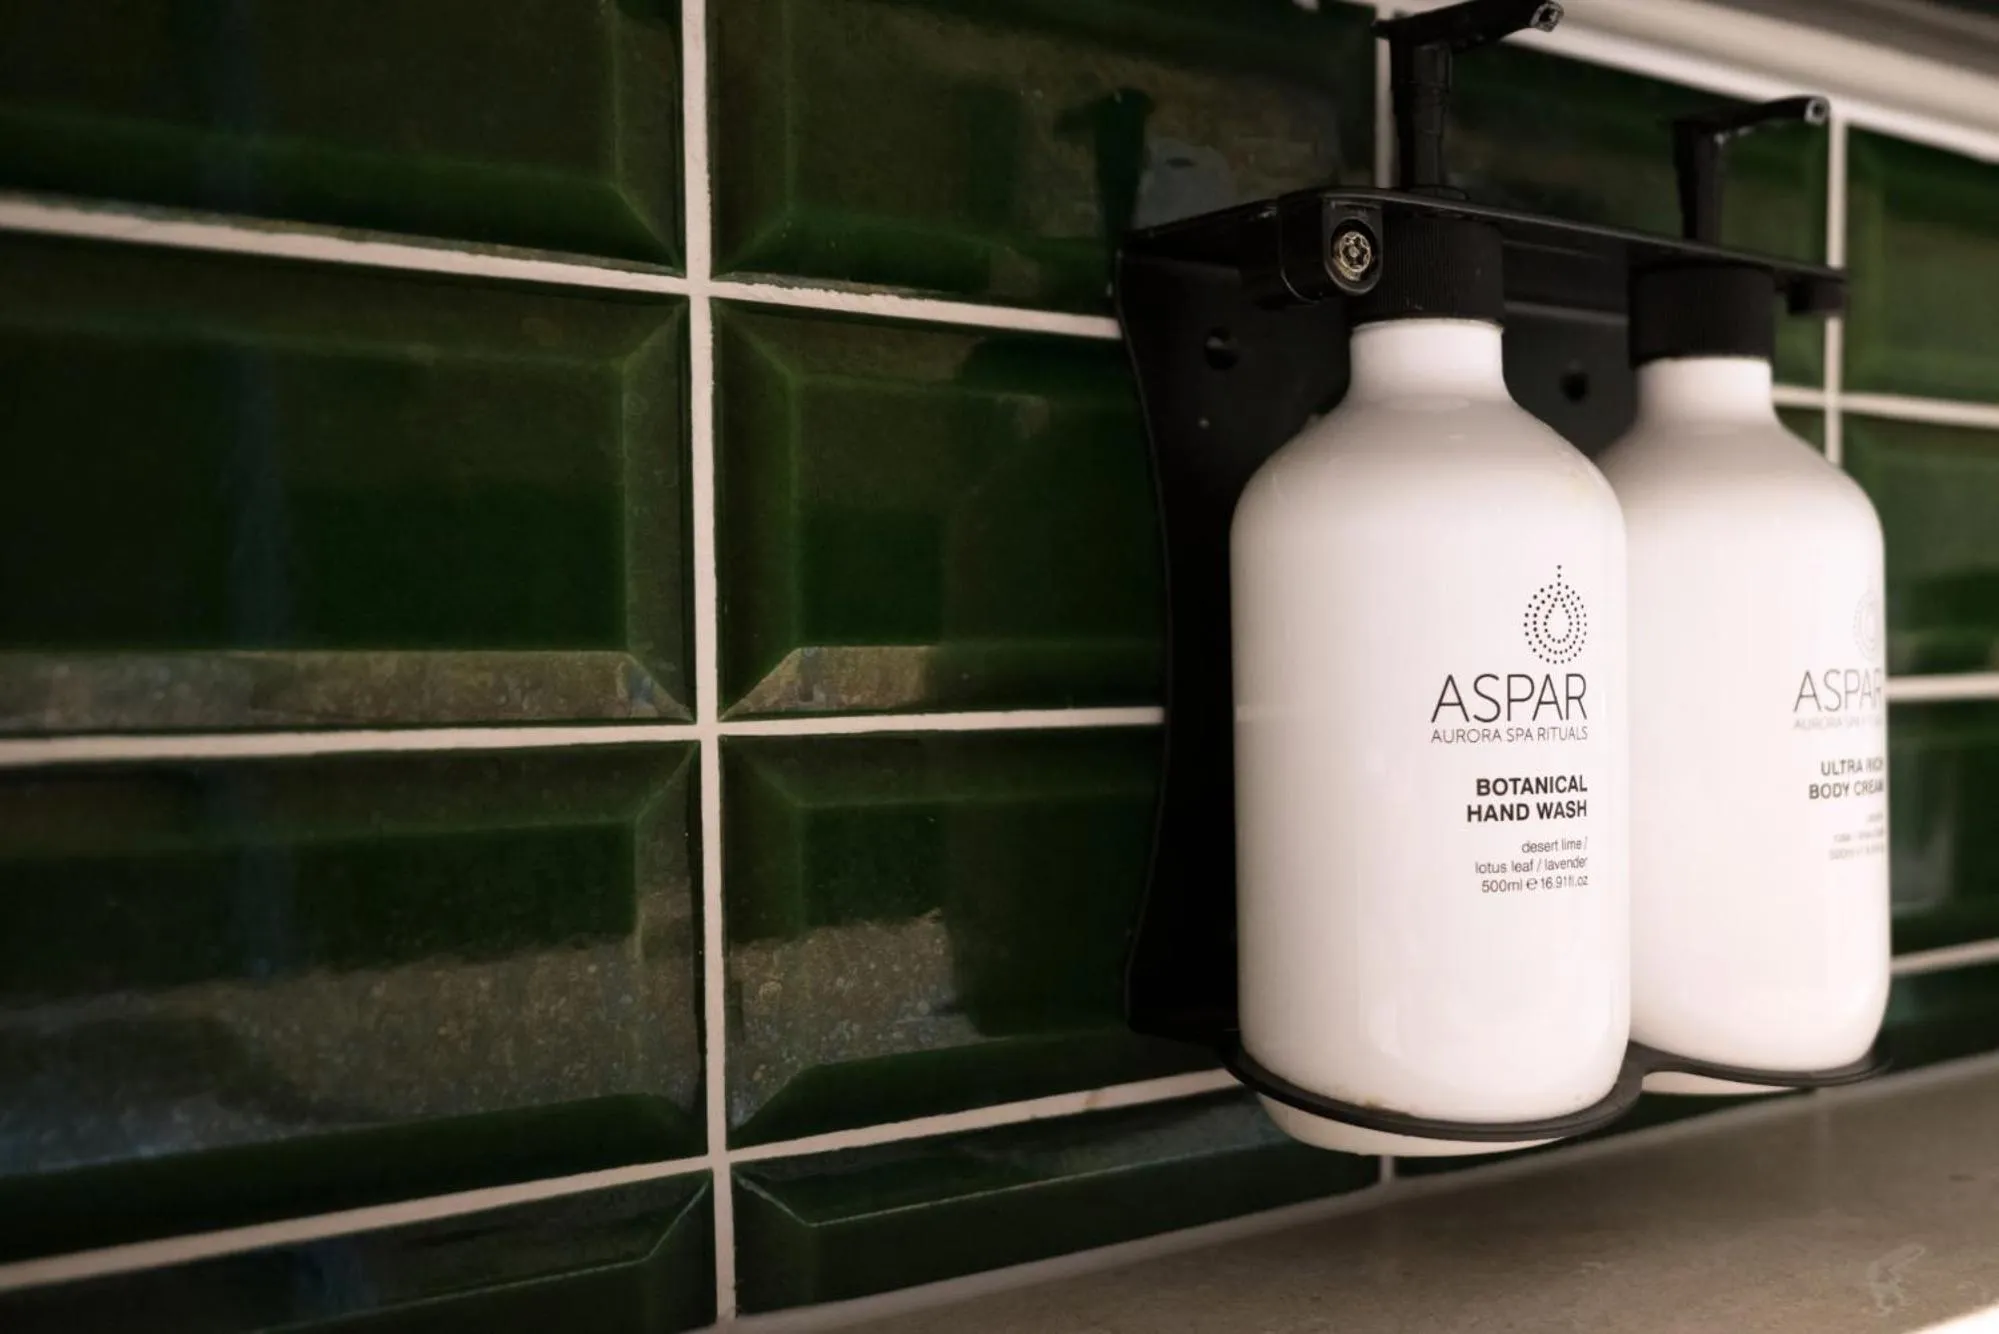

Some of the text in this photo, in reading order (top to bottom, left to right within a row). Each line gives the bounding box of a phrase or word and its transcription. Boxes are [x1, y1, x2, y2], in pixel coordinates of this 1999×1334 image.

[1431, 673, 1587, 723] ASPAR
[1431, 726, 1588, 744] AURORA SPA RITUALS
[1820, 758, 1863, 776] ULTRA
[1476, 774, 1588, 796] BOTANICAL
[1808, 782, 1849, 800] BODY
[1467, 799, 1588, 822] HAND WASH
[1521, 840, 1559, 853] desert
[1561, 837, 1582, 850] lime
[1475, 861, 1507, 874] lotus
[1511, 859, 1534, 872] leaf
[1544, 856, 1588, 871] lavender
[1481, 878, 1523, 893] 500ml
